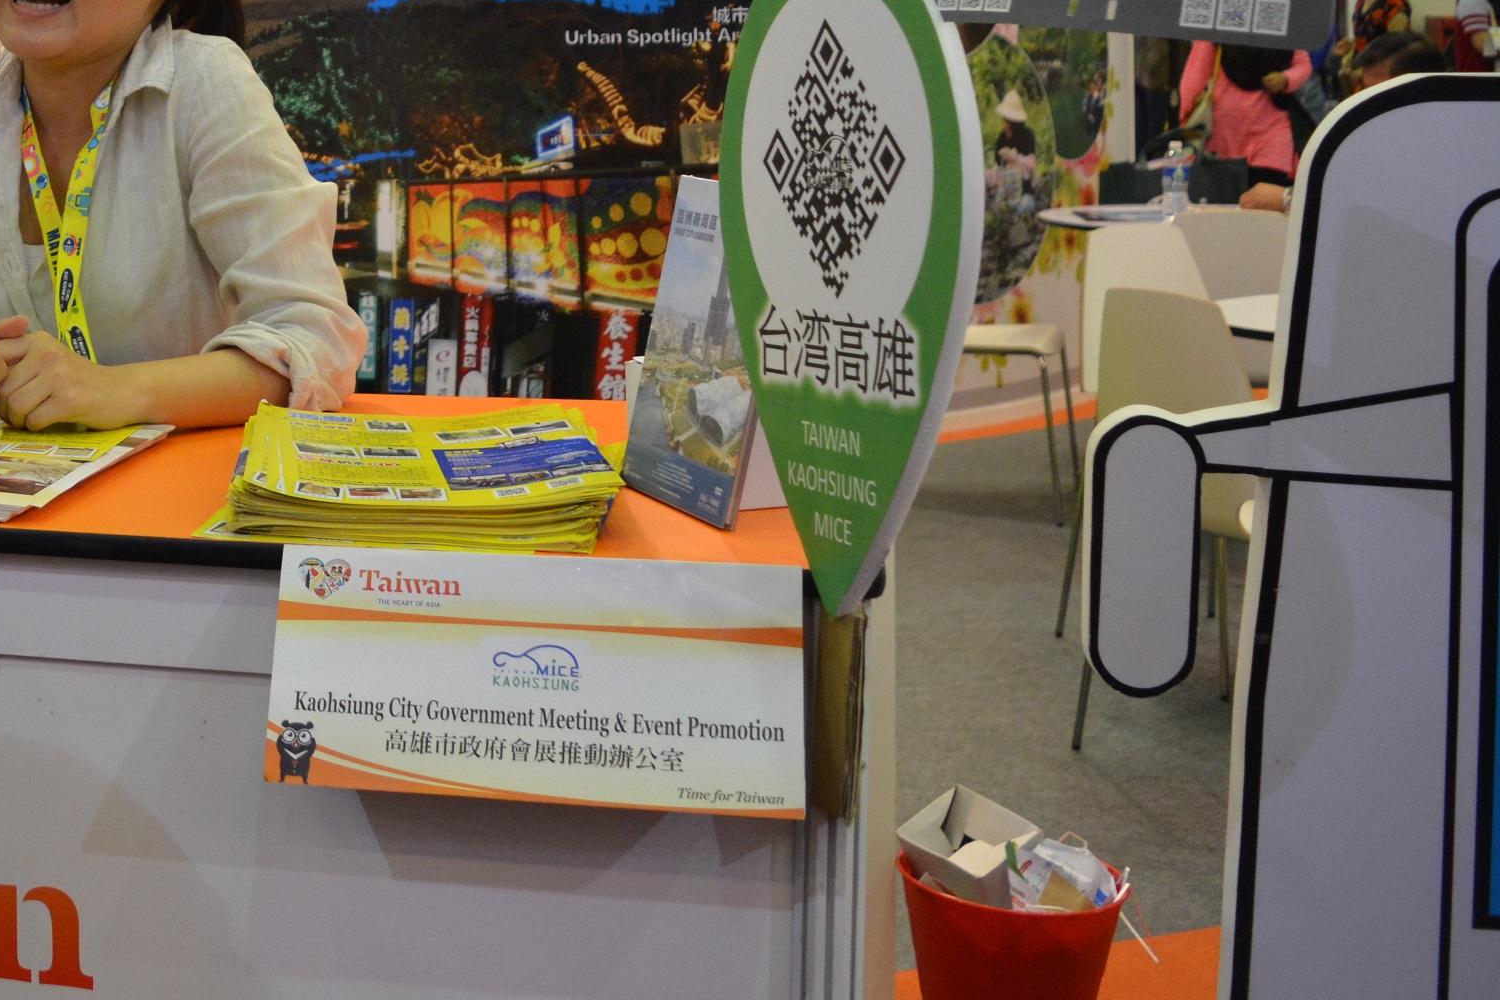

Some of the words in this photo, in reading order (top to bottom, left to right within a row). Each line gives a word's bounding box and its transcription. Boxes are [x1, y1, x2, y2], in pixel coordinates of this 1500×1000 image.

[564, 28, 622, 46] Urban
[627, 27, 711, 47] Spotlight
[758, 304, 916, 400] 台湾高雄
[801, 419, 861, 458] TAIWAN
[787, 461, 877, 507] KAOHSIUNG
[814, 512, 852, 546] MICE
[359, 569, 461, 597] Taiwan
[378, 598, 391, 606] THE
[392, 599, 414, 607] HEART
[426, 600, 441, 608] ASIA
[492, 675, 580, 692] KAOHSIUNG
[294, 691, 384, 722] Kaohsiung
[388, 696, 423, 724] City
[426, 700, 534, 727] Government
[539, 707, 609, 738] Meeting
[614, 714, 627, 733] &
[632, 713, 682, 737] Event
[687, 716, 785, 743] Promotion
[385, 729, 685, 773] 高雄市政府會展推動辦公室
[677, 786, 710, 801] Time
[710, 788, 734, 804] for
[735, 790, 785, 806] Taiwan
